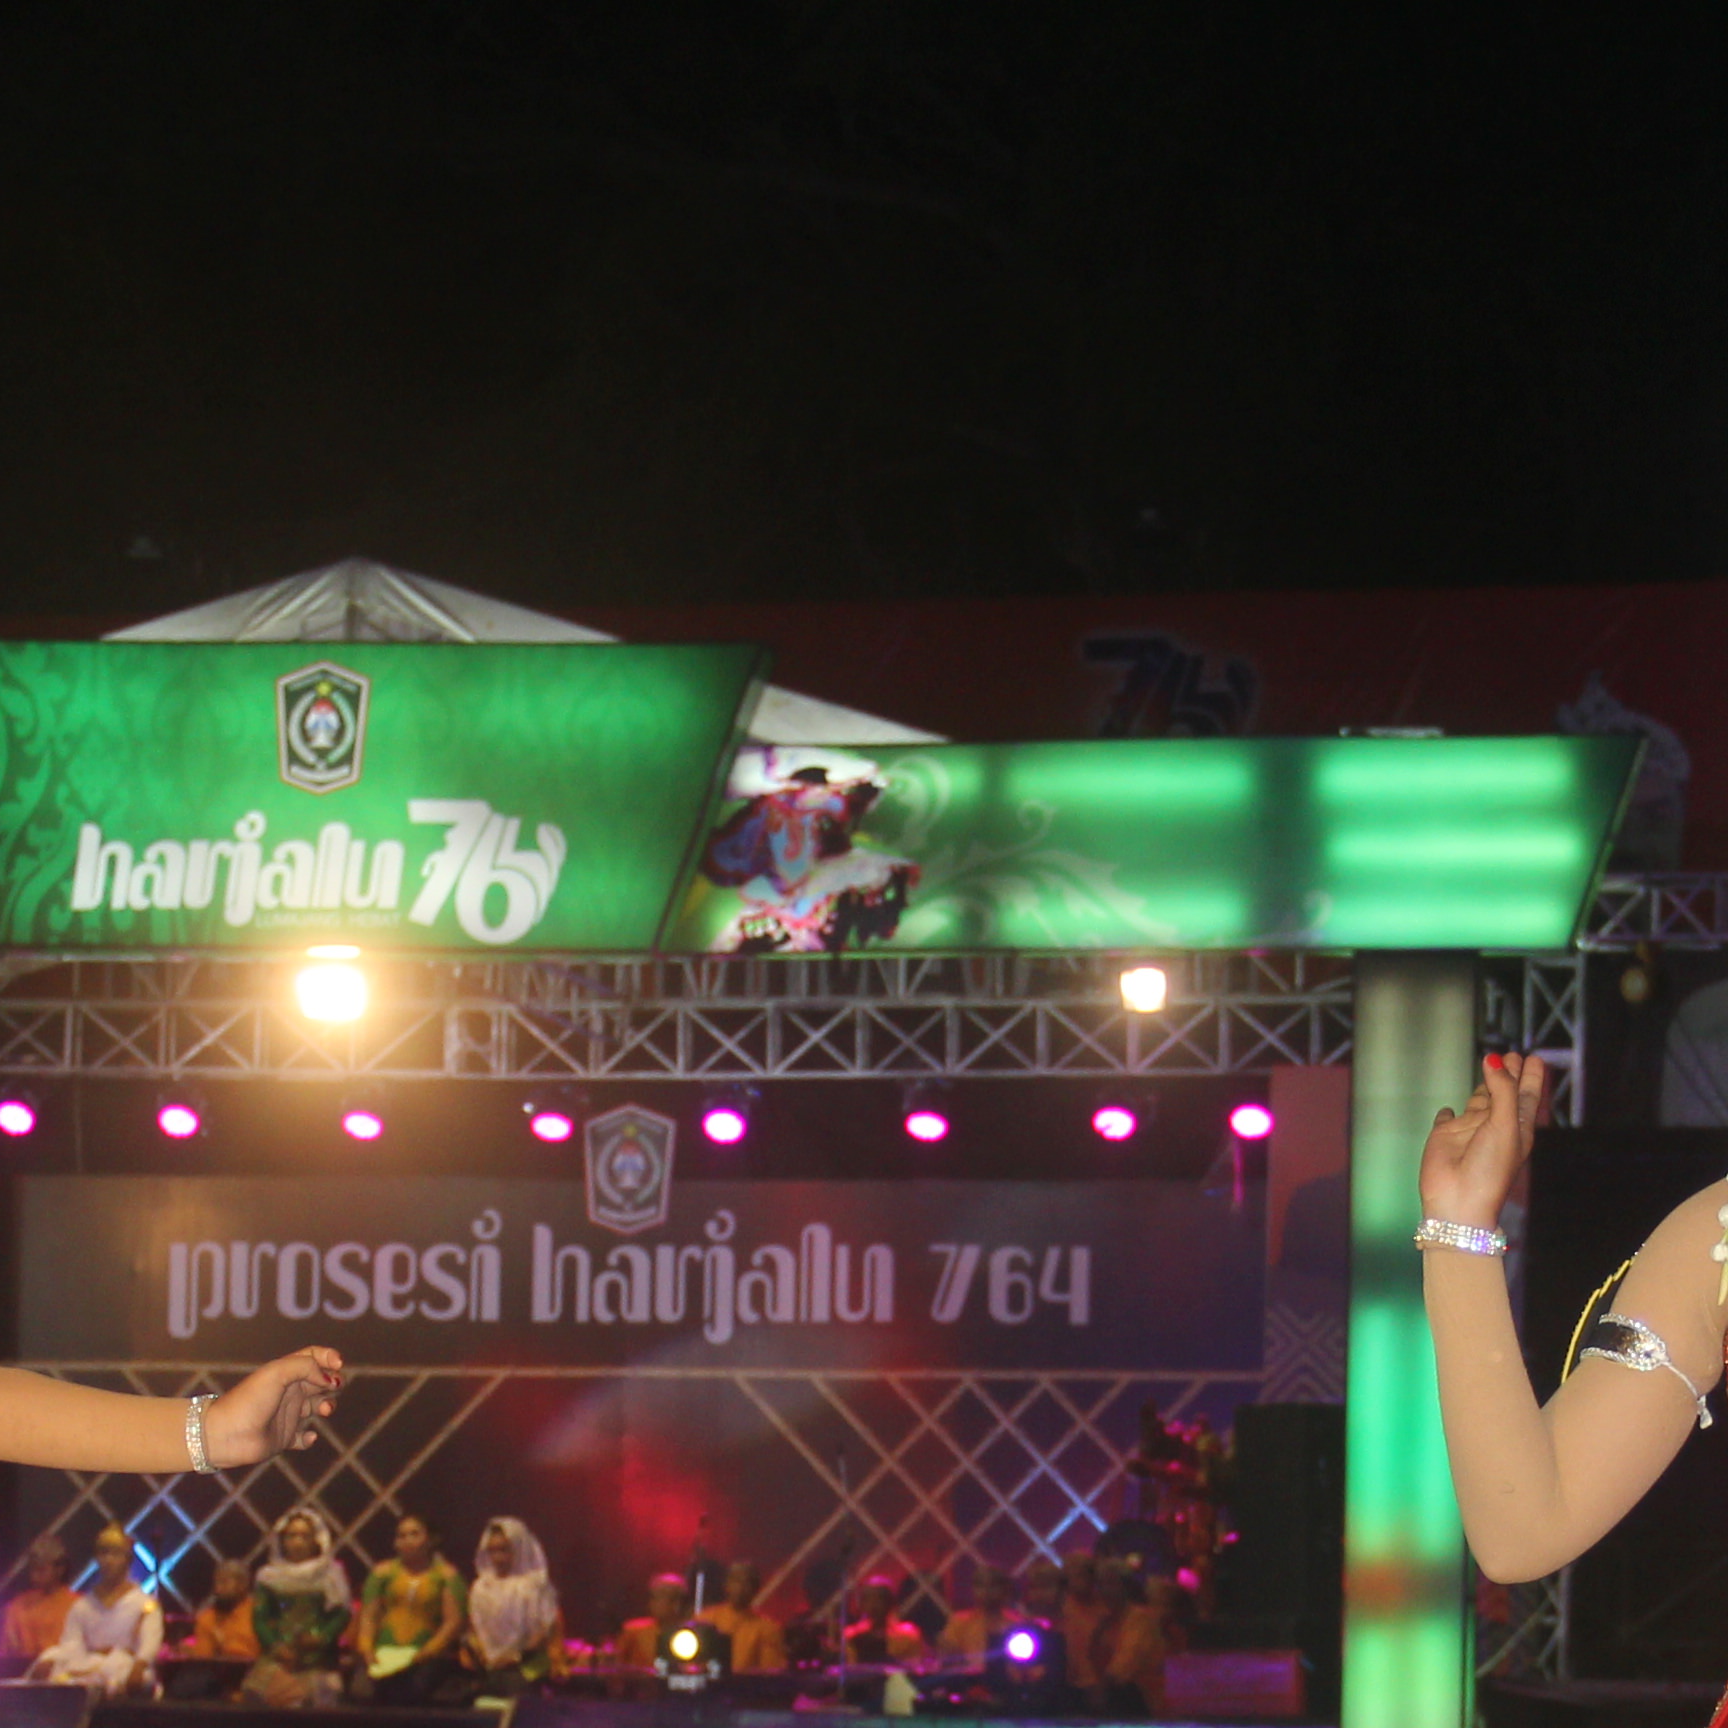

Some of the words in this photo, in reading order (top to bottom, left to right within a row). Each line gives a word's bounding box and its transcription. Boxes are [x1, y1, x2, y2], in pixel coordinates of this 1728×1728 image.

[168, 1208, 504, 1340] prosesi
[532, 1208, 895, 1345] harjalu
[928, 1243, 1091, 1325] 764
